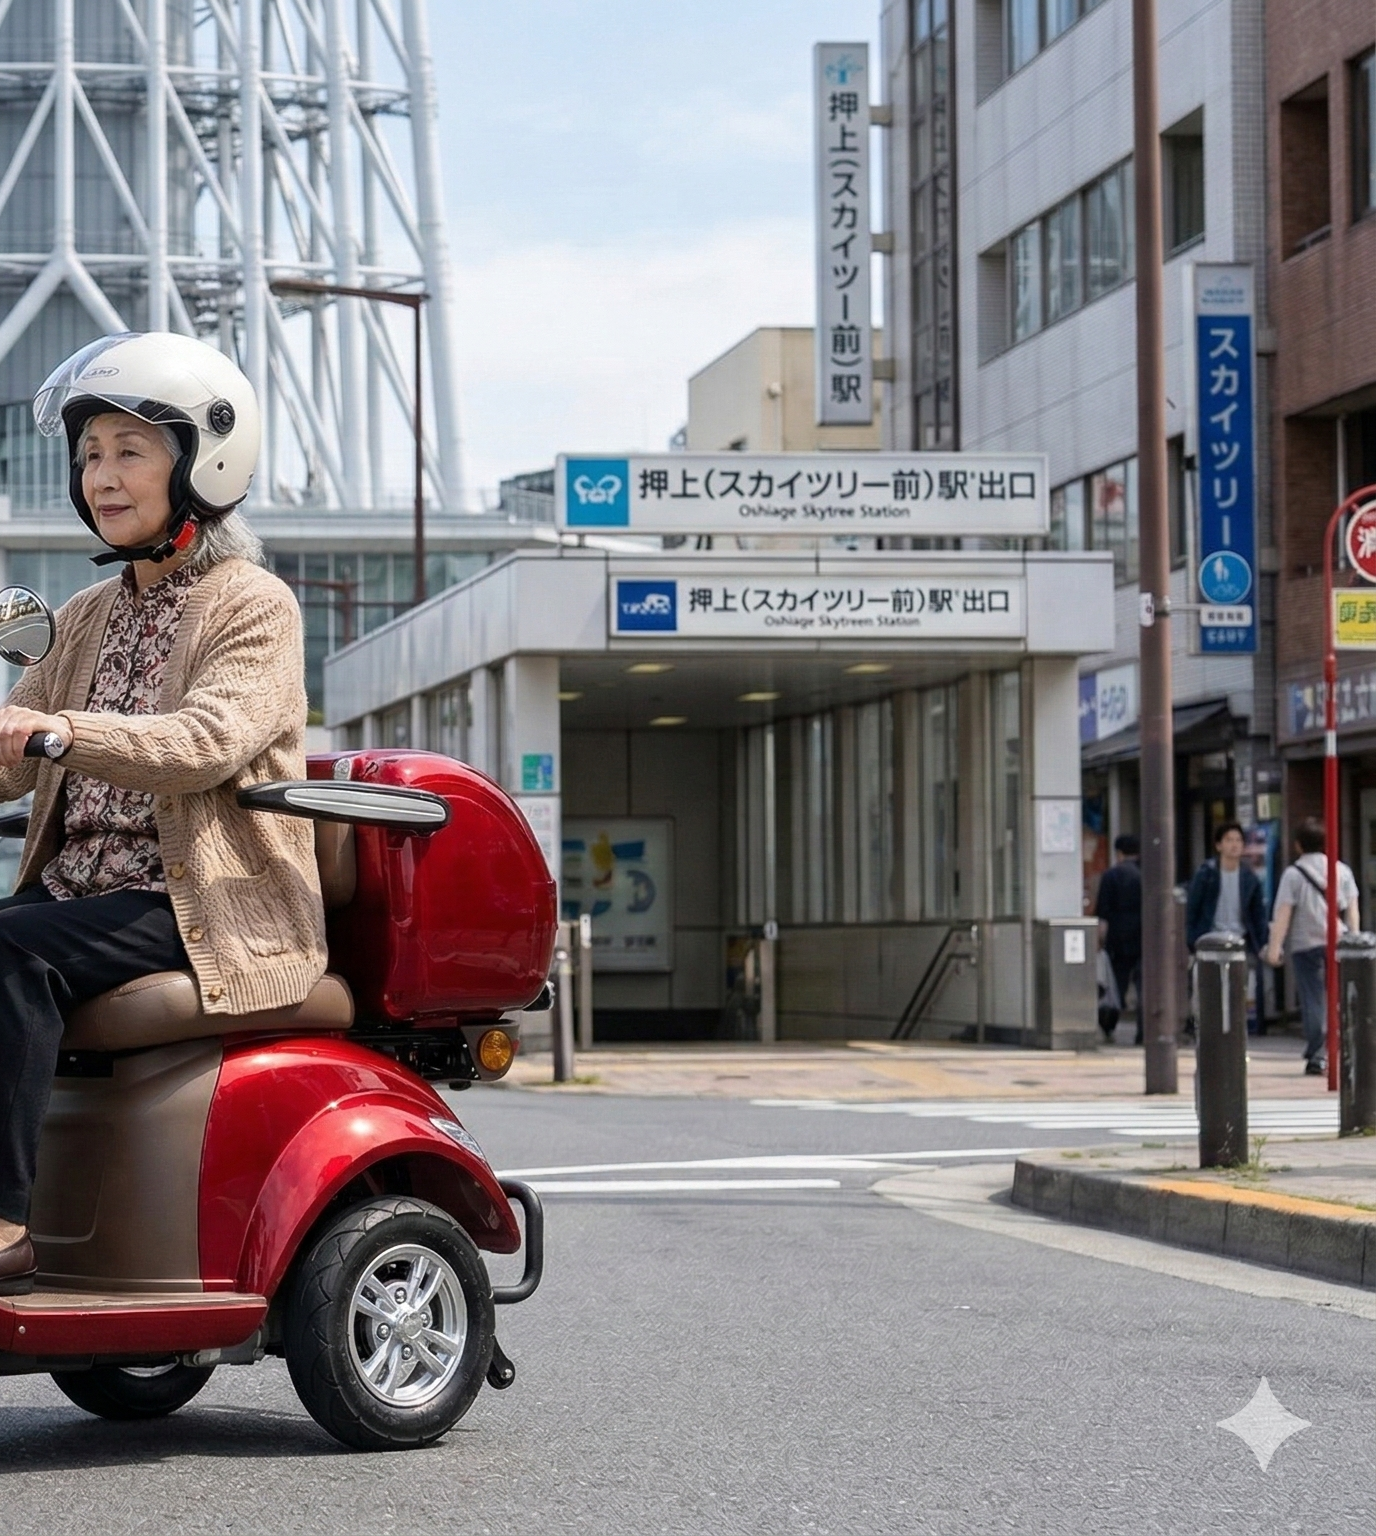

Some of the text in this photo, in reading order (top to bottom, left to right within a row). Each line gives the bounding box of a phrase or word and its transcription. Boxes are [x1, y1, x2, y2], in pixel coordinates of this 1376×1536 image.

[828, 91, 863, 405] 押上(スカイツー前)駅
[738, 504, 910, 520] Oshiage Skytree Station
[1208, 327, 1241, 548] スカイツリー
